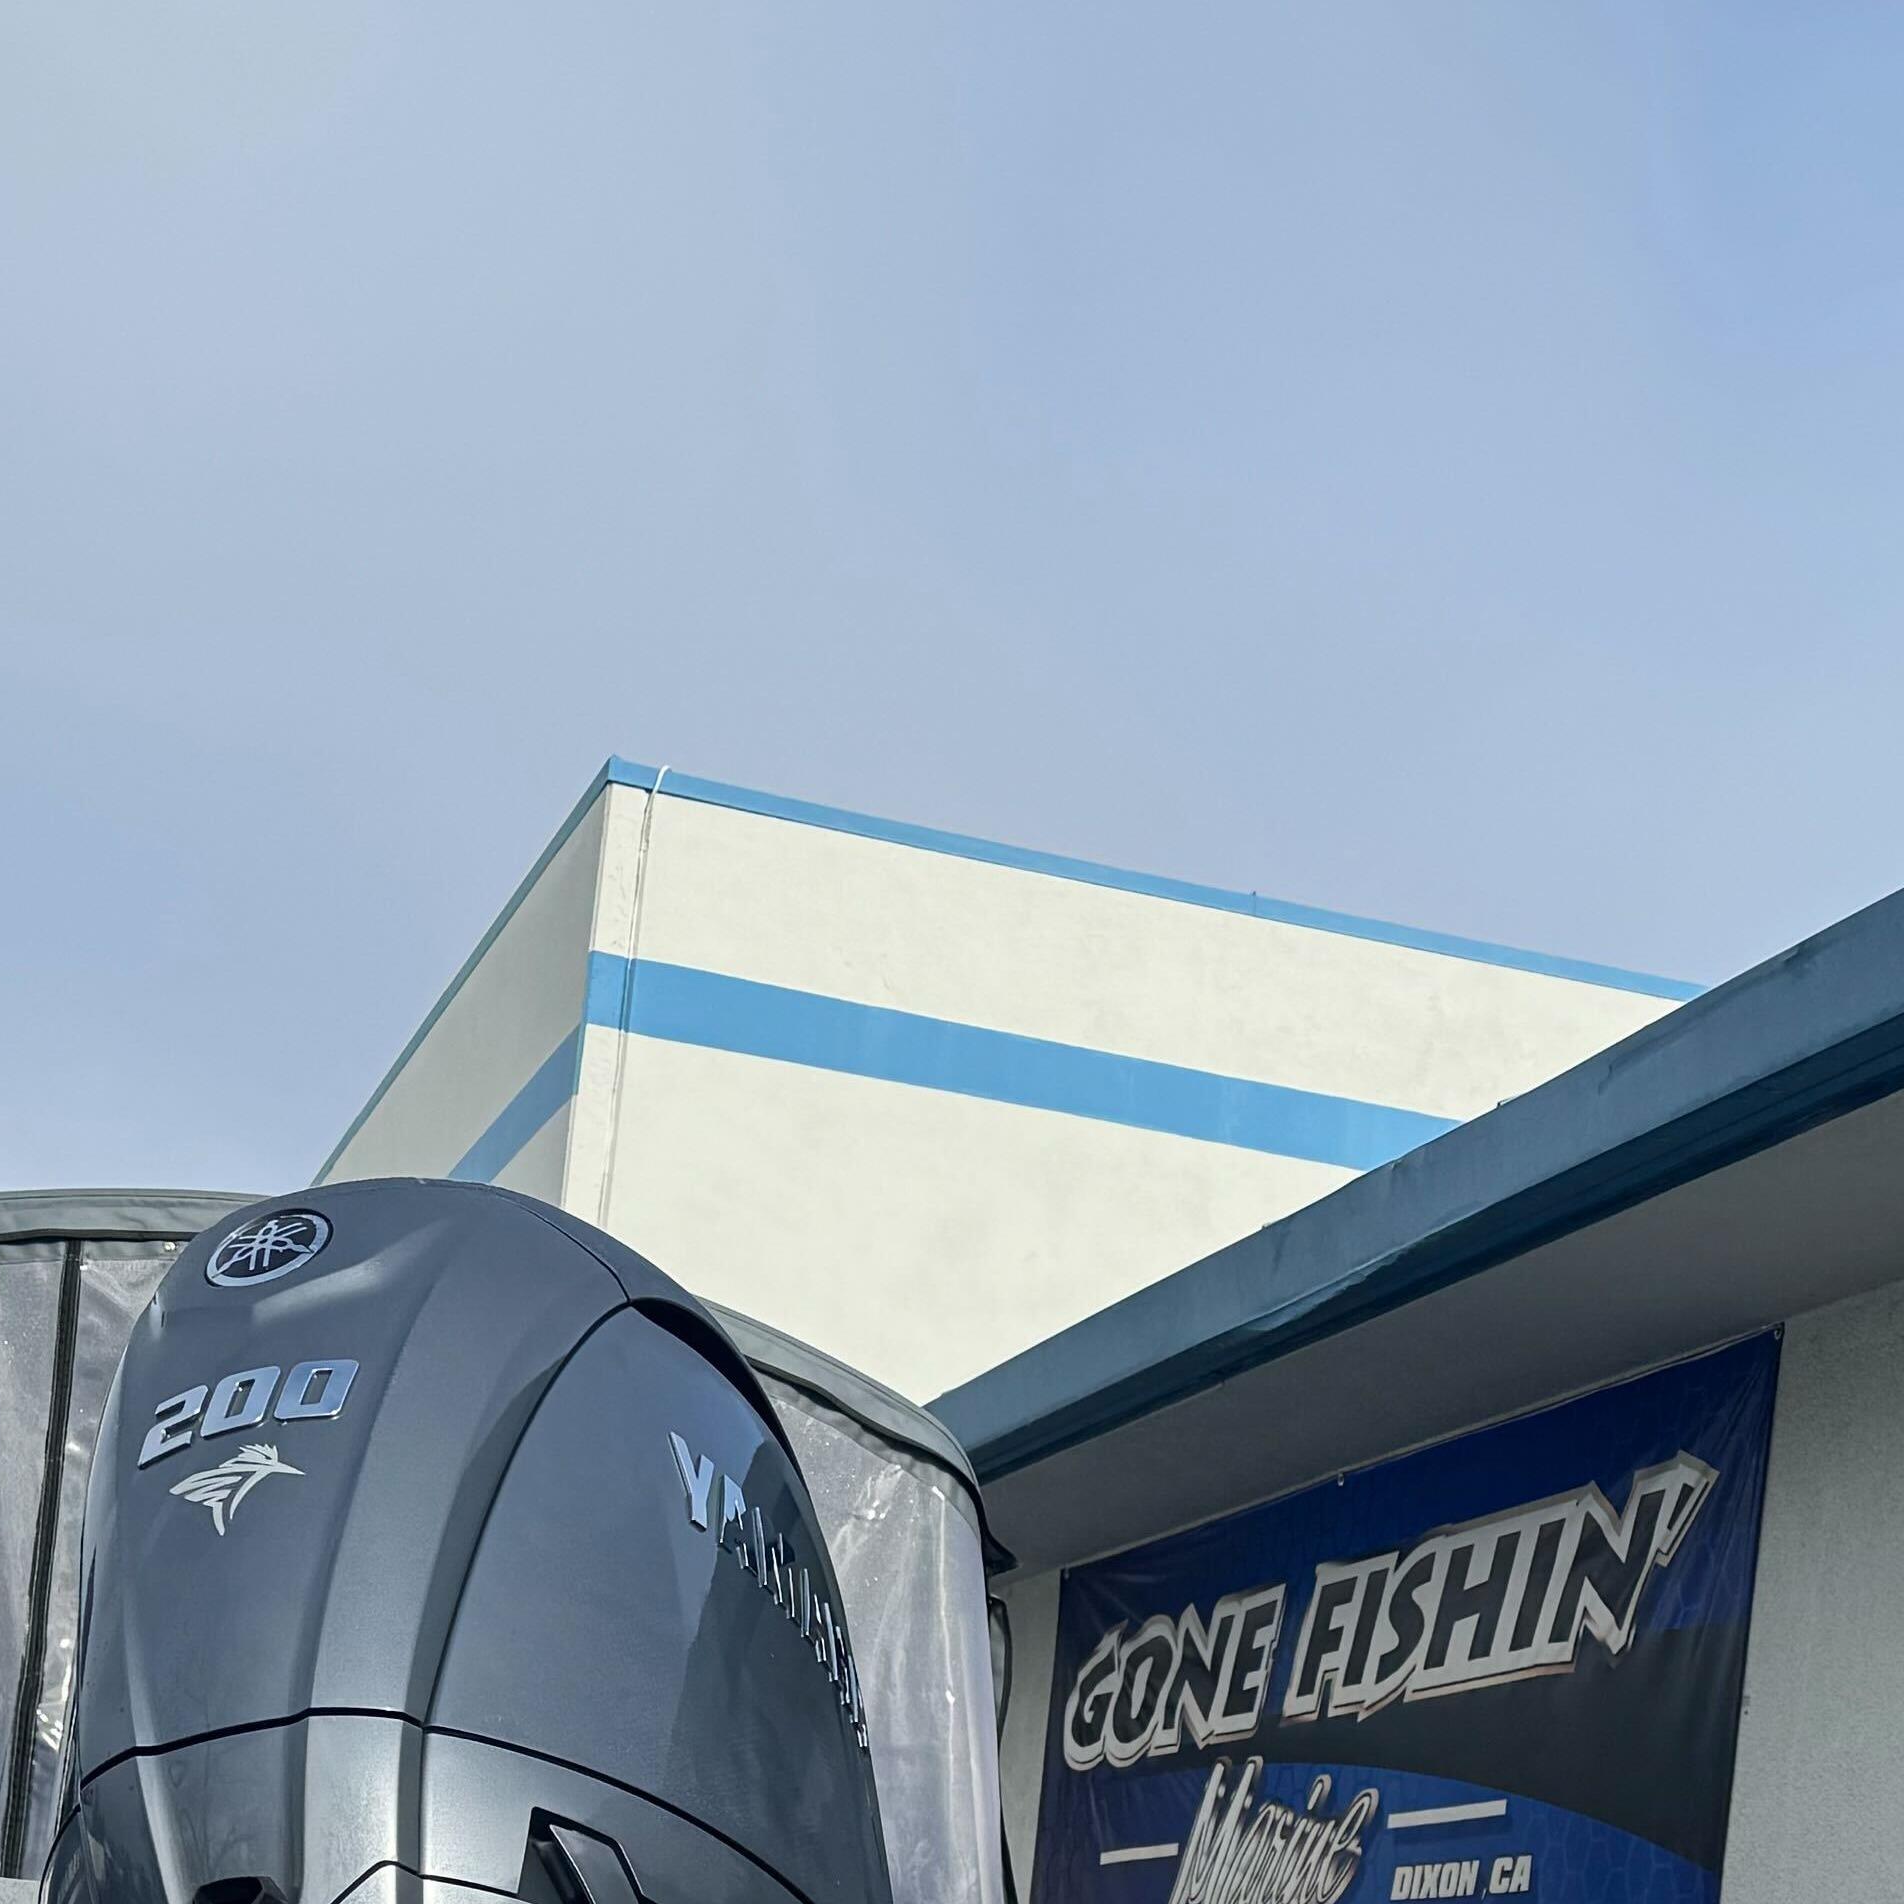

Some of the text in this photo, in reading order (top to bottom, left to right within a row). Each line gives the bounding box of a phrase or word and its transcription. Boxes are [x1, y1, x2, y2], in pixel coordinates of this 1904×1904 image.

[137, 1358, 360, 1470] 200
[1062, 1582, 1286, 1772] GONE
[1489, 1855, 1533, 1894] CA
